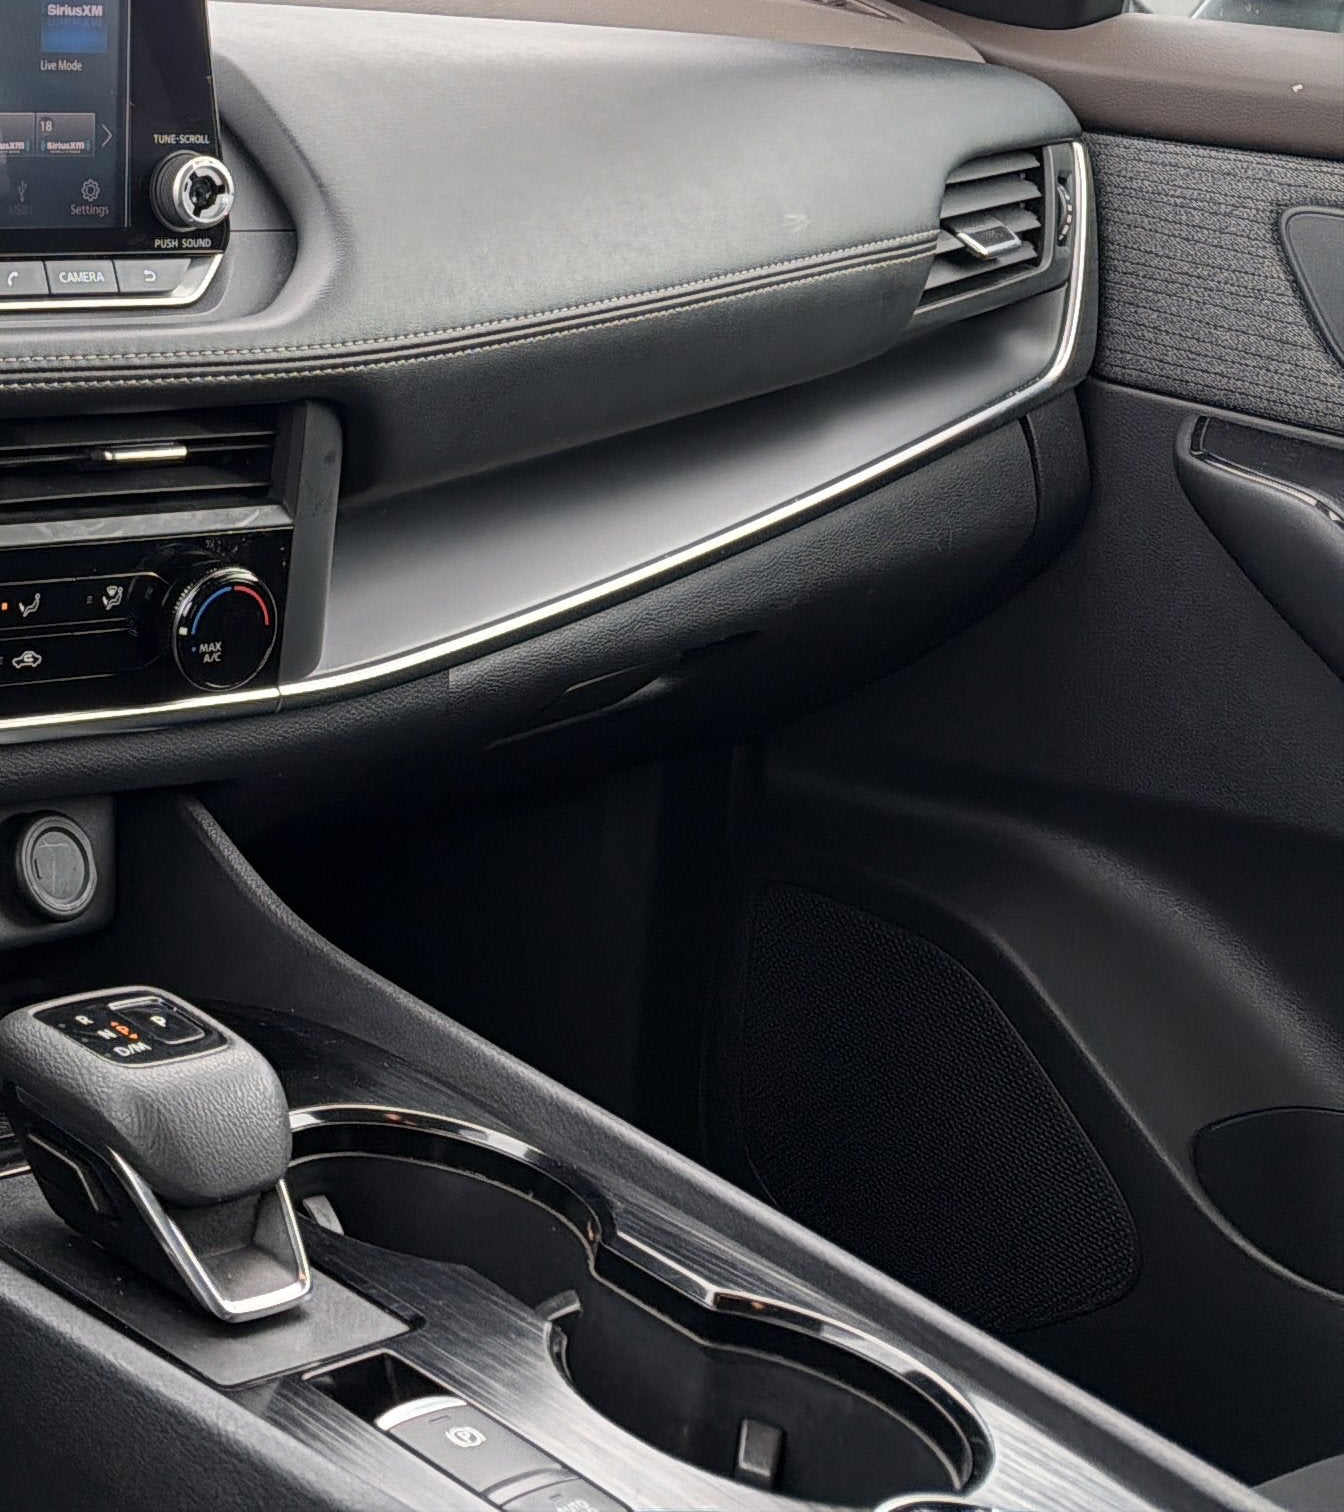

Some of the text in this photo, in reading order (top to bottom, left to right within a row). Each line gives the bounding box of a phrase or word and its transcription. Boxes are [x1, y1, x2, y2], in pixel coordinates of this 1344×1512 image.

[47, 4, 103, 16] SiriusXM
[40, 60, 82, 72] Live Mode
[40, 120, 53, 132] 18
[70, 203, 110, 218] Settings
[154, 239, 212, 248] PUSH SOUND
[59, 272, 105, 283] CAMERA
[199, 641, 223, 654] MAX
[203, 652, 222, 664] A/C
[75, 1014, 94, 1026] R
[150, 1015, 167, 1028] P
[97, 1028, 117, 1040] N
[113, 1041, 153, 1057] D/M
